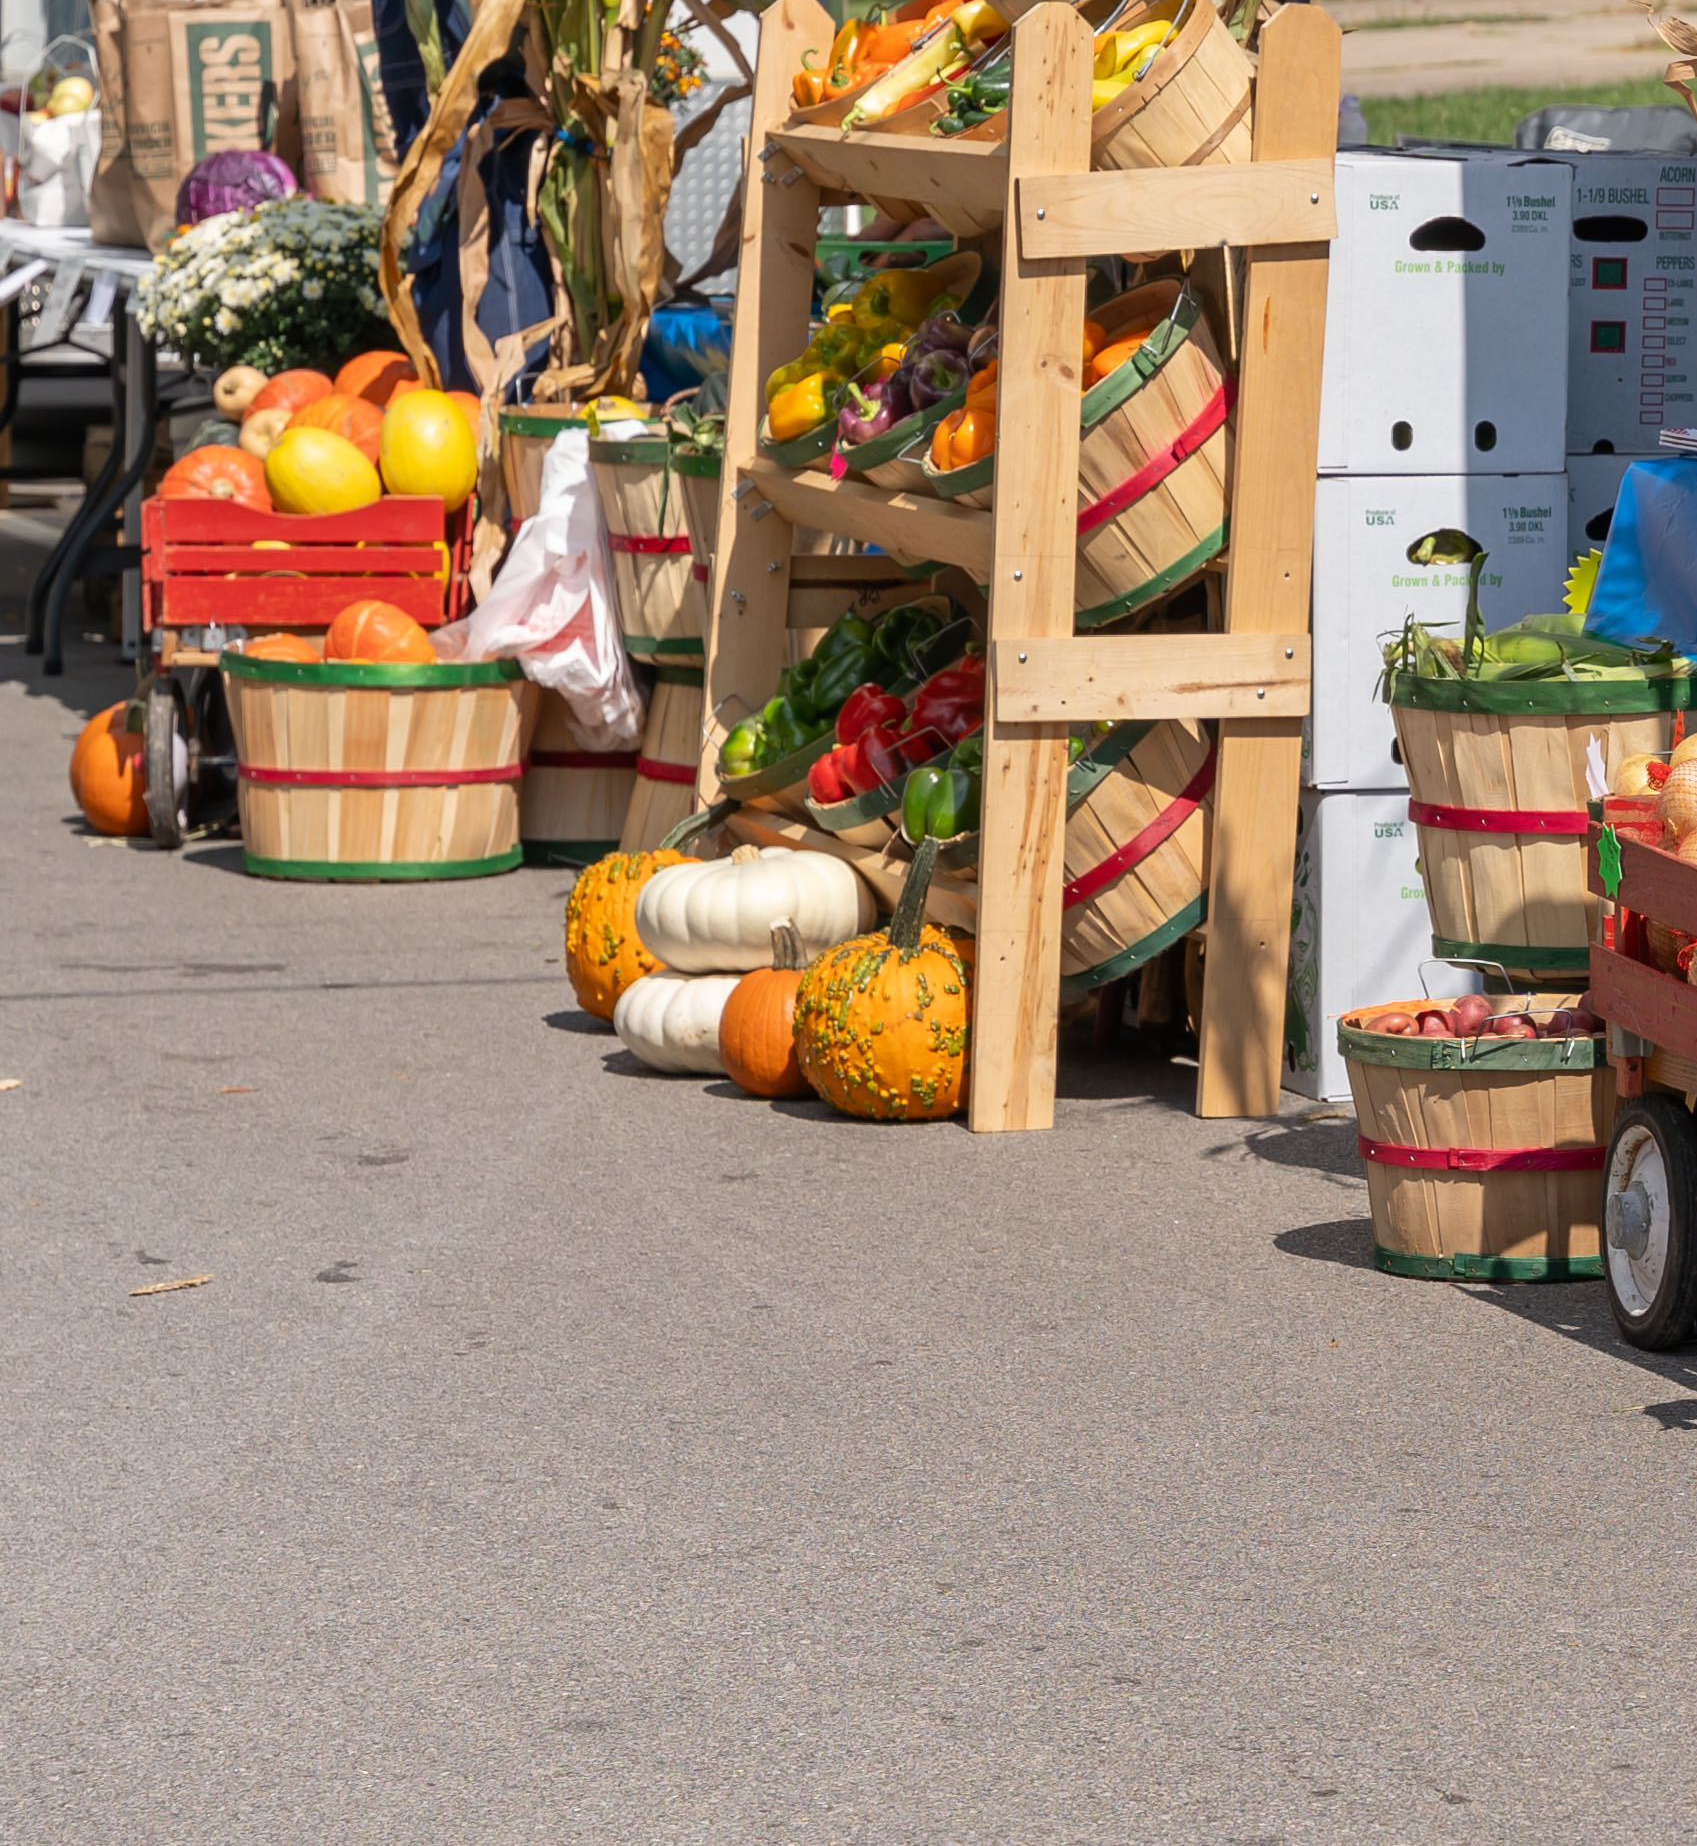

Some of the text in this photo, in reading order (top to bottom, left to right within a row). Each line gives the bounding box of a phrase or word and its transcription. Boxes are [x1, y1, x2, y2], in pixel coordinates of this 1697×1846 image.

[199, 33, 263, 153] KERS
[1659, 167, 1696, 183] ACORN
[1523, 196, 1556, 208] Bushel
[1577, 188, 1650, 204] 1-1/9 BUSHEL
[1370, 200, 1399, 210] USA
[1512, 210, 1548, 221] 3.90 DKL
[1395, 260, 1505, 277] Grown & Packed by
[1656, 256, 1696, 271] PEPPERS
[1571, 278, 1586, 287] LECT
[1519, 506, 1552, 518] Bushel
[1366, 515, 1395, 526] USA
[1509, 521, 1545, 532] 3.90 DKL
[1392, 574, 1503, 589] Grown & Packd by
[1374, 827, 1404, 838] USA
